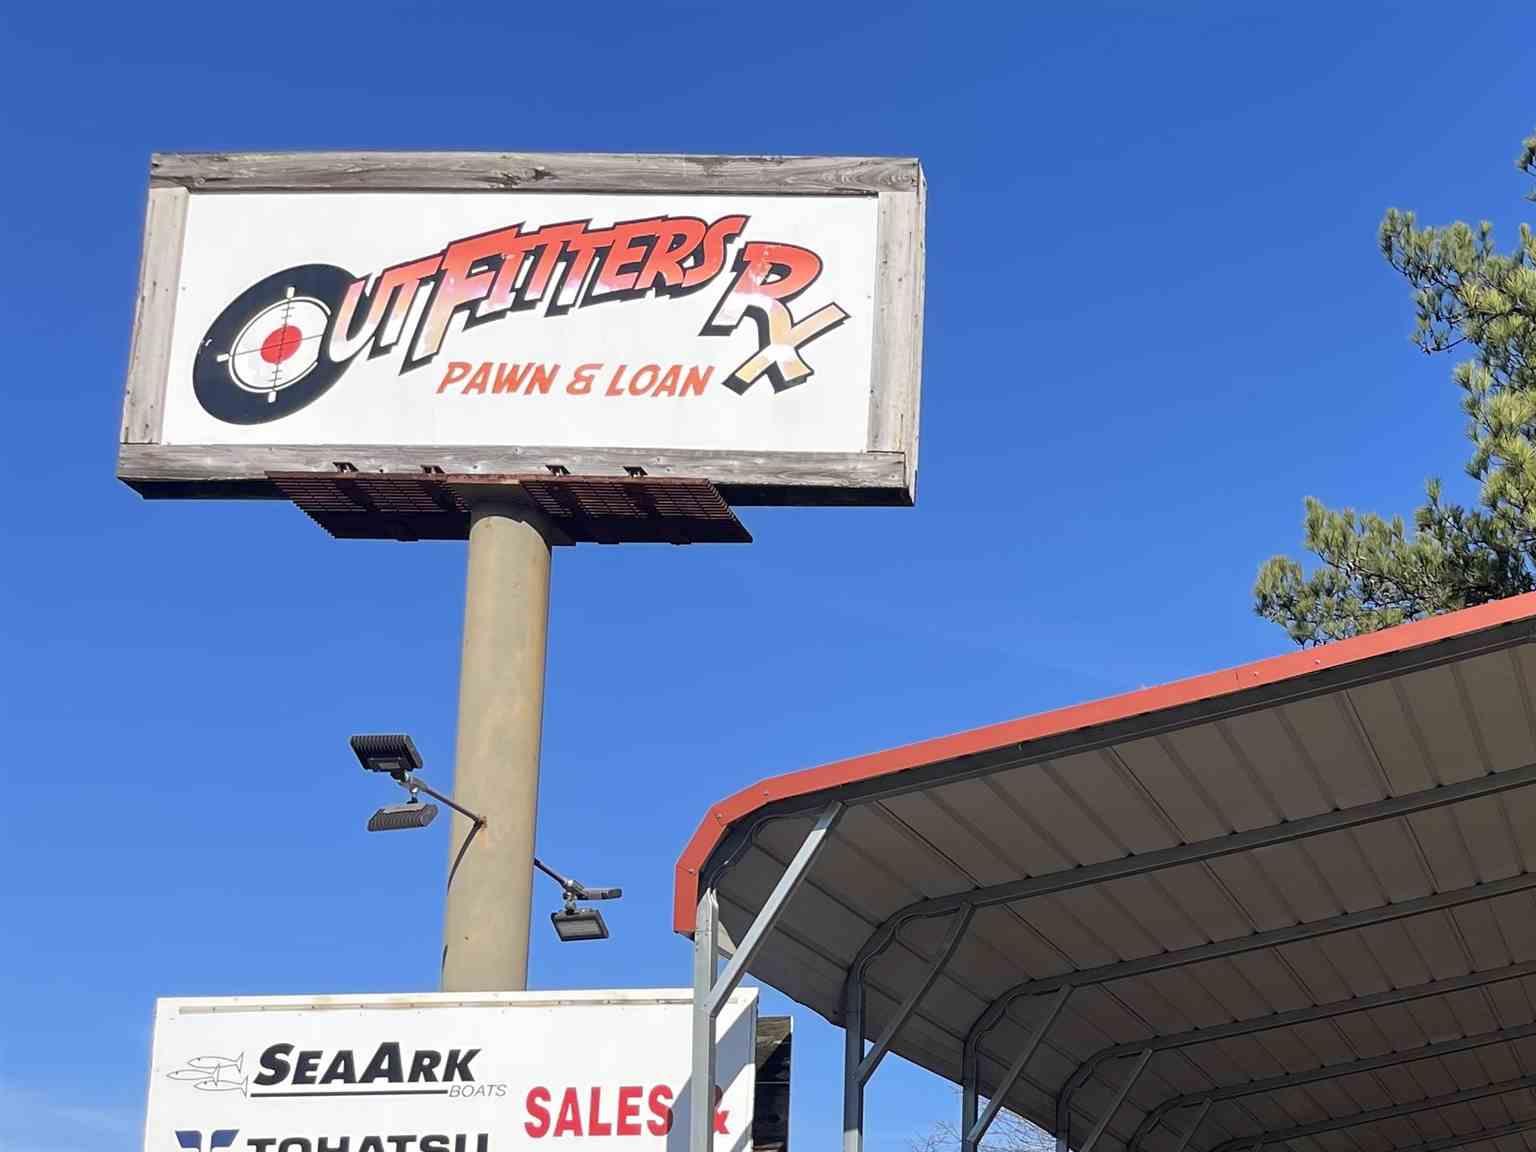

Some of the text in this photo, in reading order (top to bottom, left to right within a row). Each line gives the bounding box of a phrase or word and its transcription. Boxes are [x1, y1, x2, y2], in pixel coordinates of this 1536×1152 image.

[436, 362, 714, 398] PAWN & LOAN
[448, 1083, 507, 1098] BOATS
[523, 1084, 675, 1139] SALES
